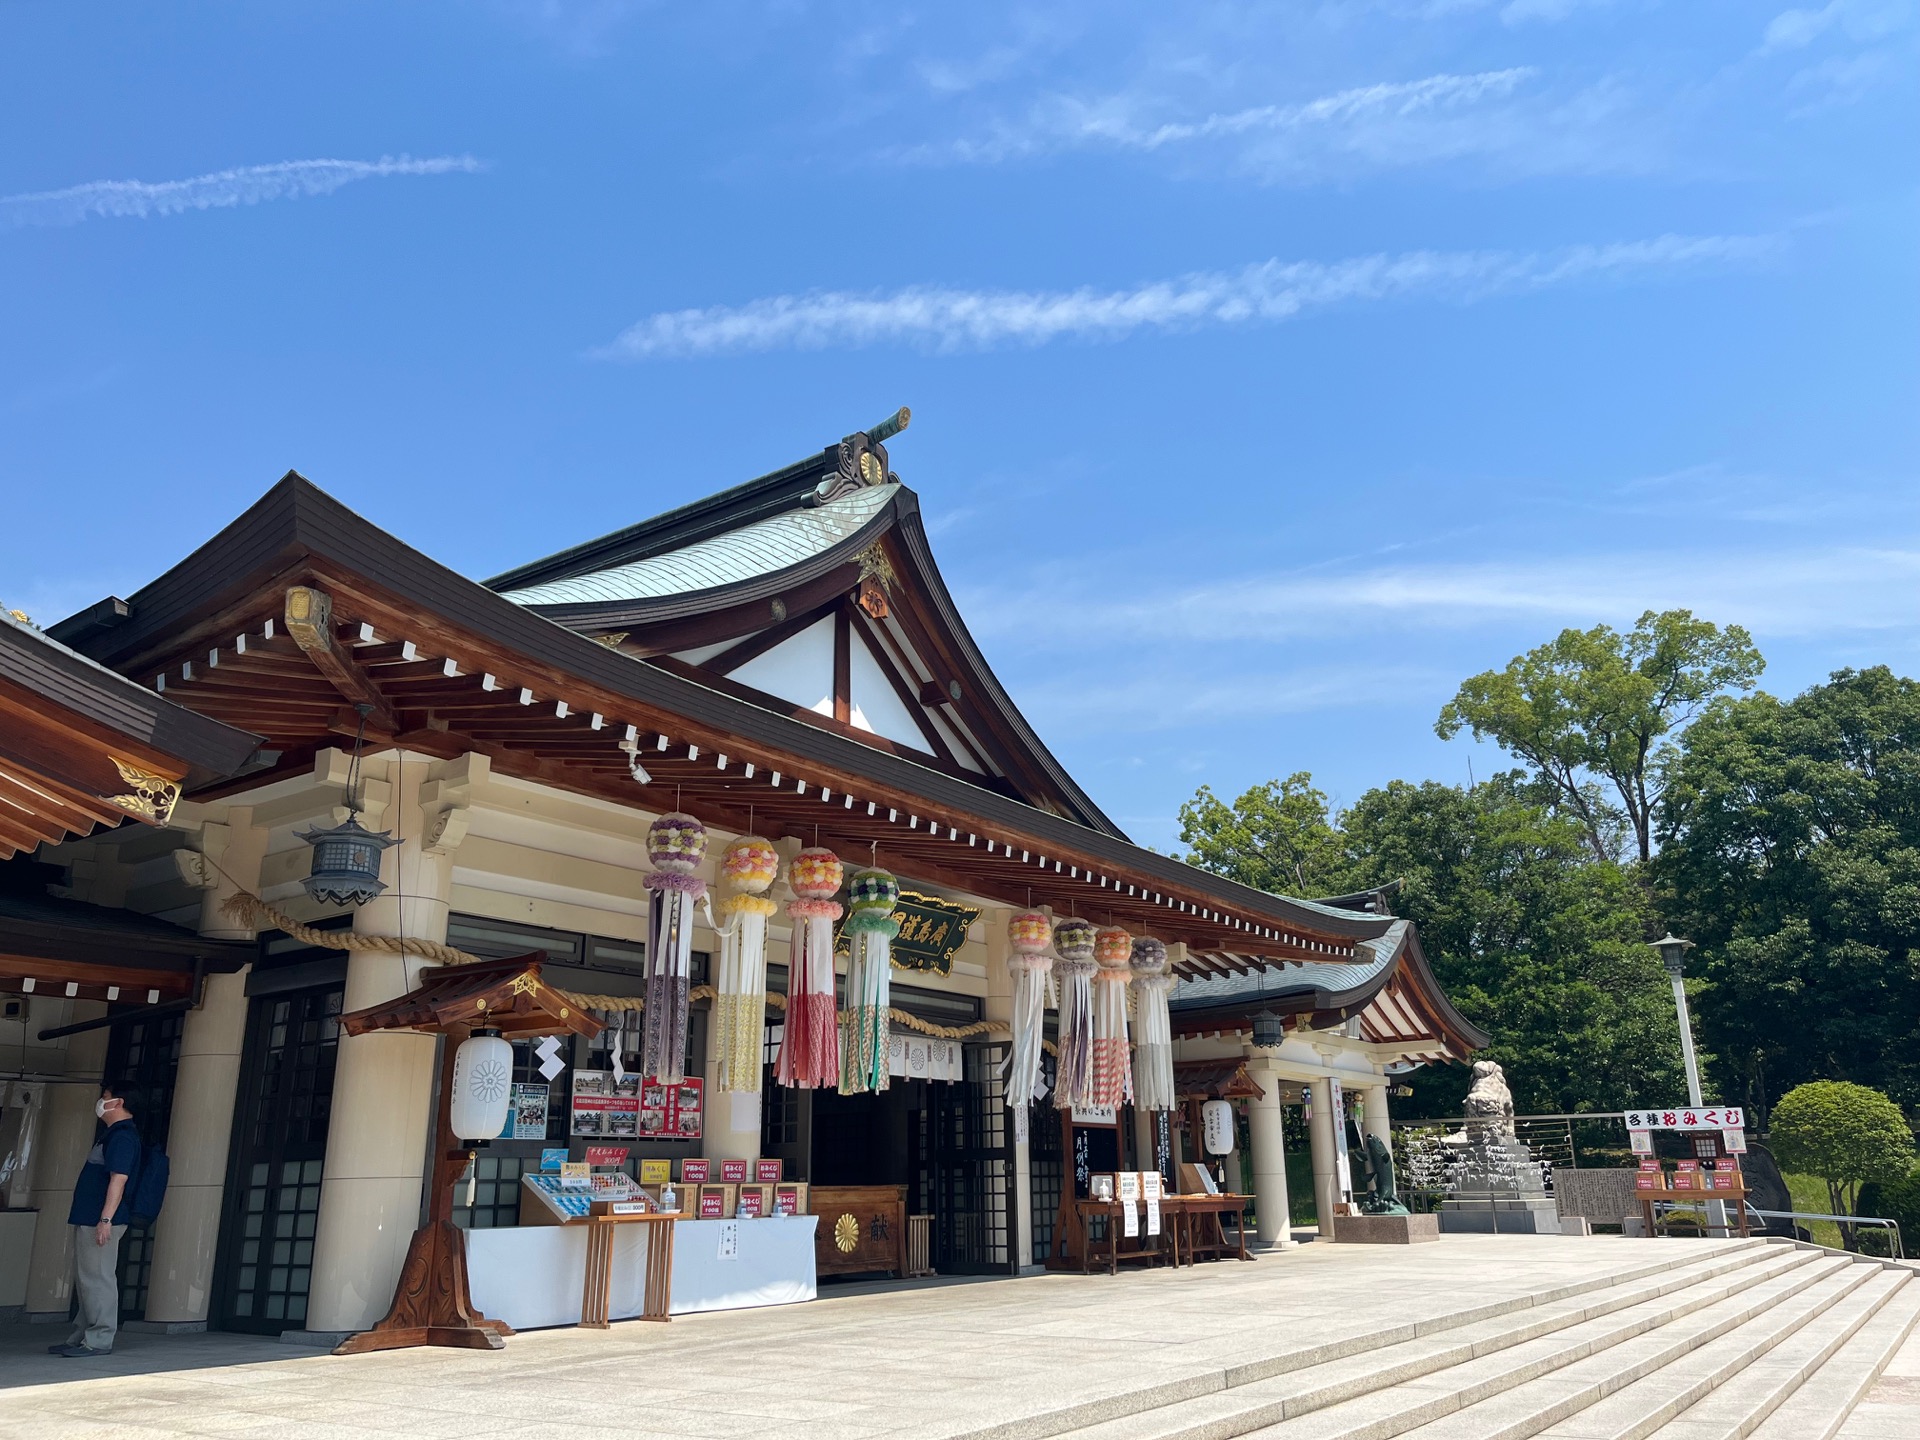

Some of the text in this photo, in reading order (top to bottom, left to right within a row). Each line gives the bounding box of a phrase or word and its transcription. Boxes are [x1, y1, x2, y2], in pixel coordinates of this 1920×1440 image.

[1628, 1110, 1740, 1127] 各種おみくじ
[760, 1164, 778, 1172] おみくじ
[1075, 1136, 1085, 1182] 月例祭
[870, 1213, 890, 1242] 献
